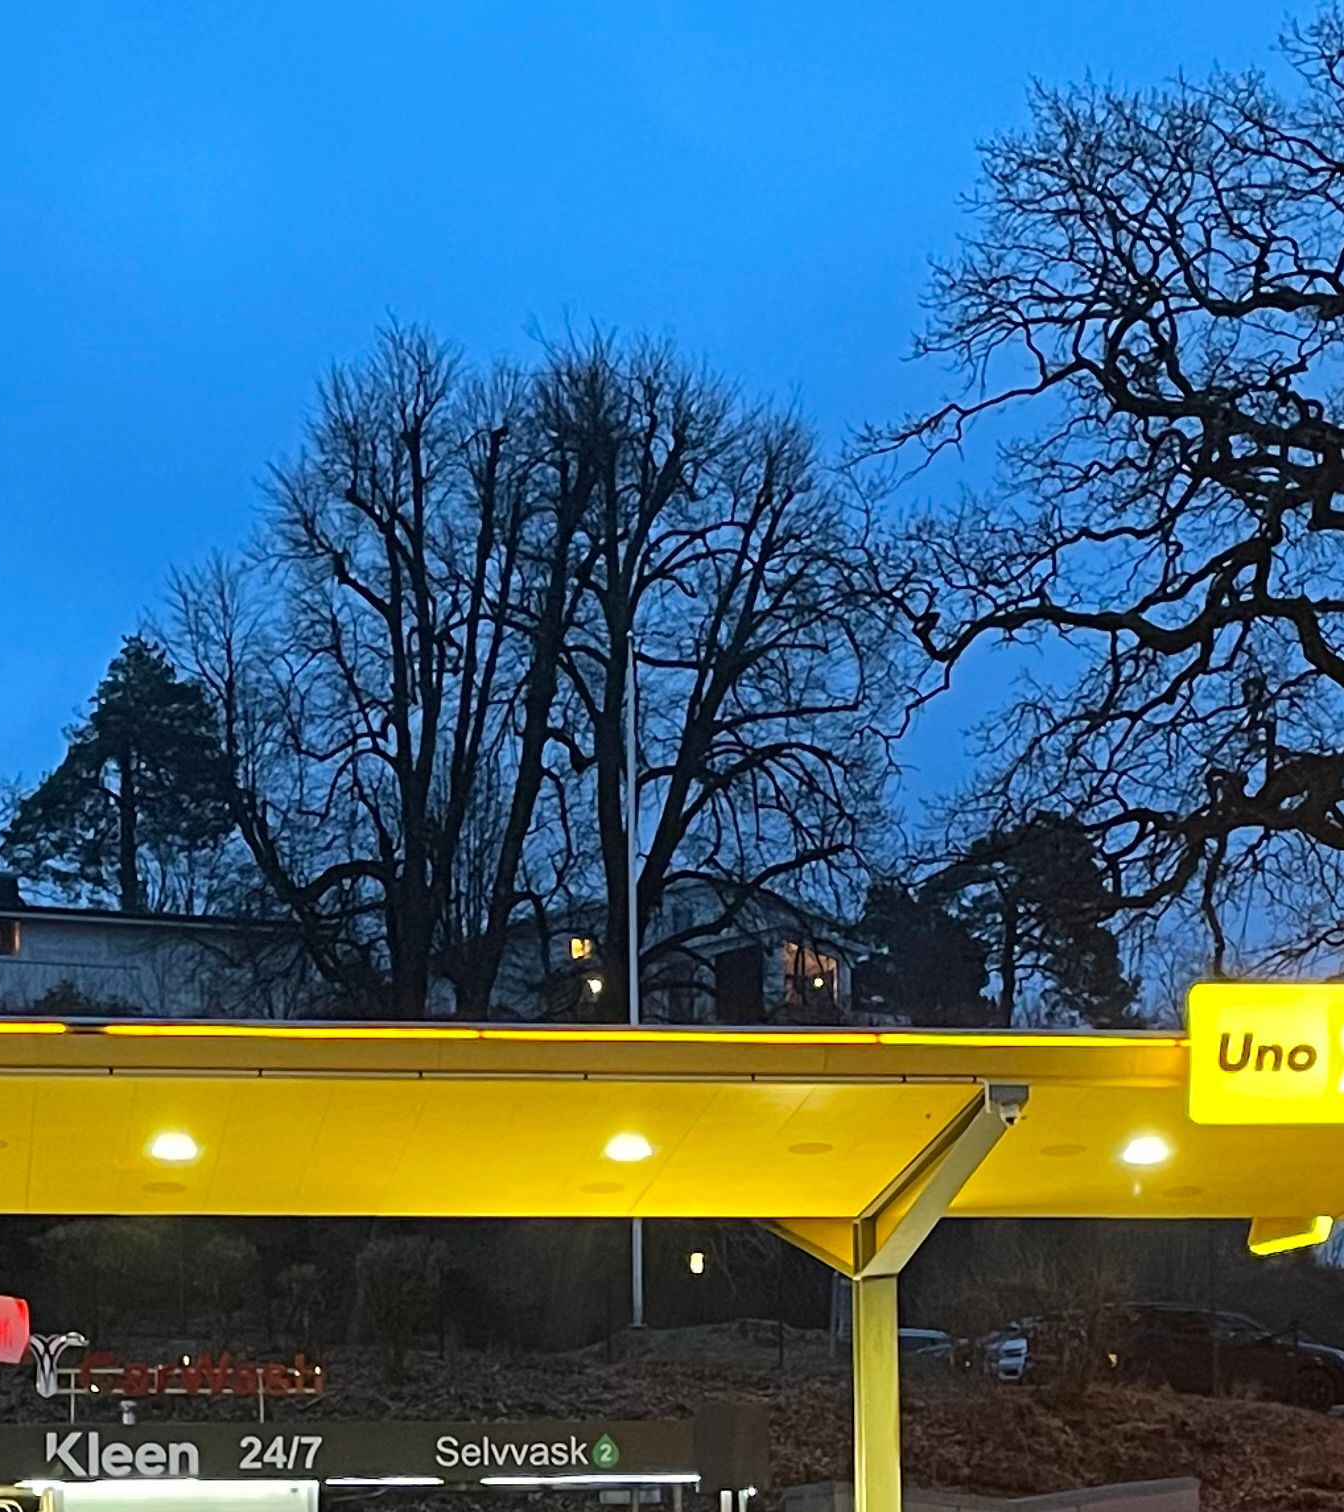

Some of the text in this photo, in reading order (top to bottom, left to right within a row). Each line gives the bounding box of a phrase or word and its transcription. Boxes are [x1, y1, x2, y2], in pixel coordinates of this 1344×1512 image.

[1219, 1032, 1317, 1073] Uno
[46, 1431, 323, 1477] Kleen 24/7
[435, 1435, 612, 1467] Selvvask 2
